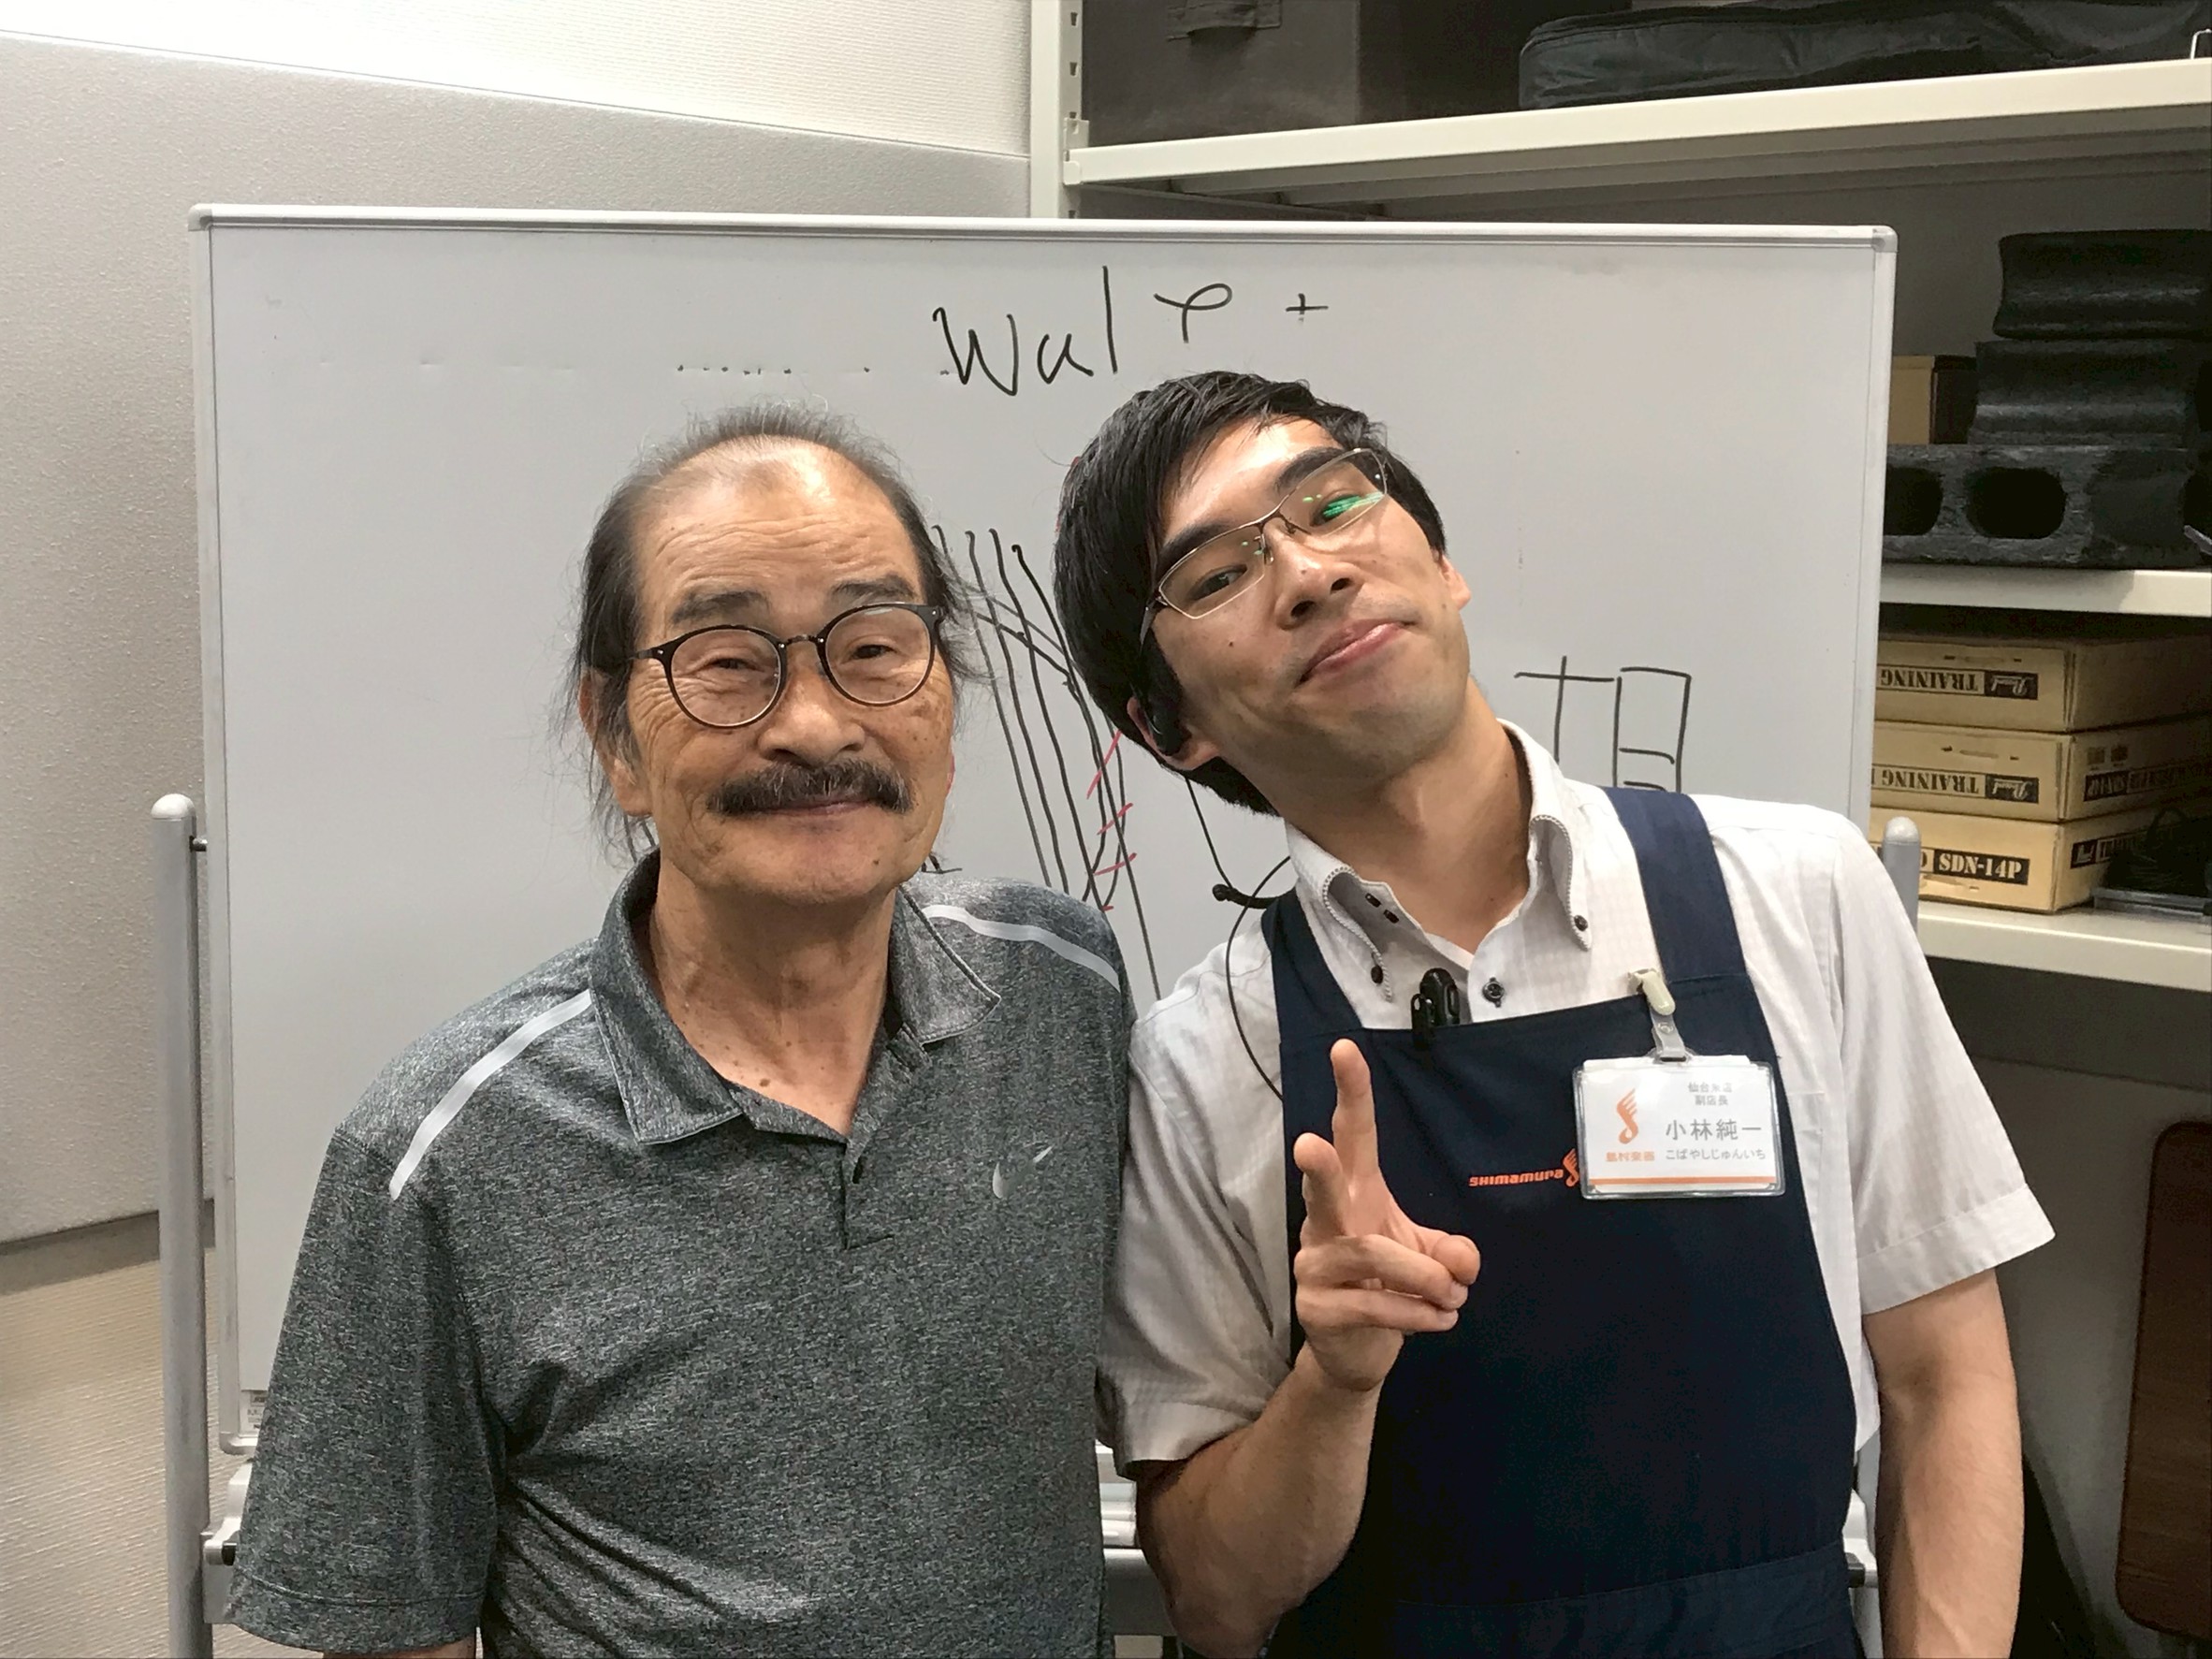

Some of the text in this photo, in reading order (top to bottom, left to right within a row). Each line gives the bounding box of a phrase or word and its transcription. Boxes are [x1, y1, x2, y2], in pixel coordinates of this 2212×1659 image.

[1881, 668, 1979, 692] TRAINING
[1882, 769, 1980, 794] TRAINING
[1938, 852, 2022, 880] SDN-14P
[1666, 1118, 1762, 1141] 小林純一
[1666, 1148, 1766, 1160] こばやしじゅんいち
